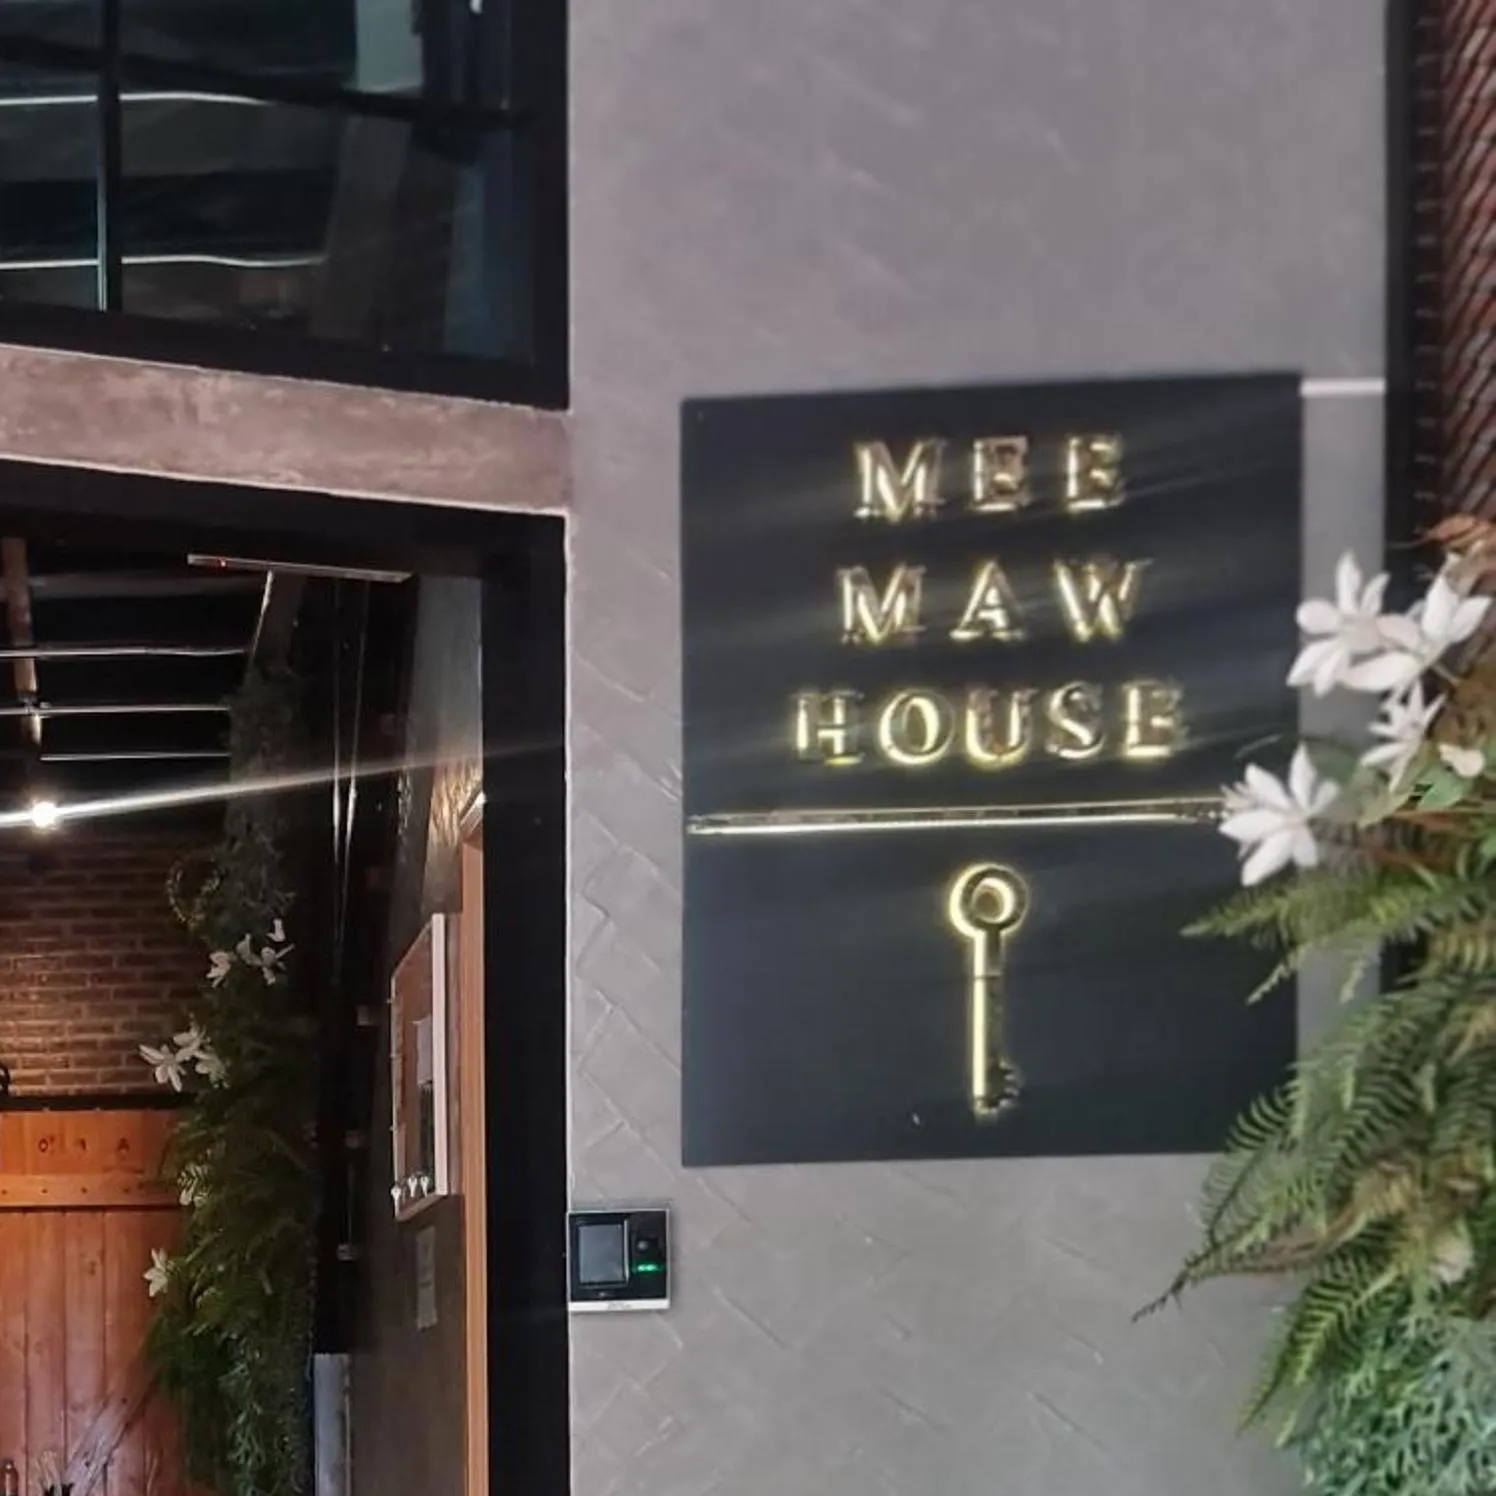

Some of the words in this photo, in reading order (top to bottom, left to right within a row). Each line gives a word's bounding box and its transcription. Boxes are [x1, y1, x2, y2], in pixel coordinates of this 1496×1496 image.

[853, 433, 1126, 522] MEE
[836, 557, 1153, 645] MAW
[788, 678, 1190, 769] HOUSE
